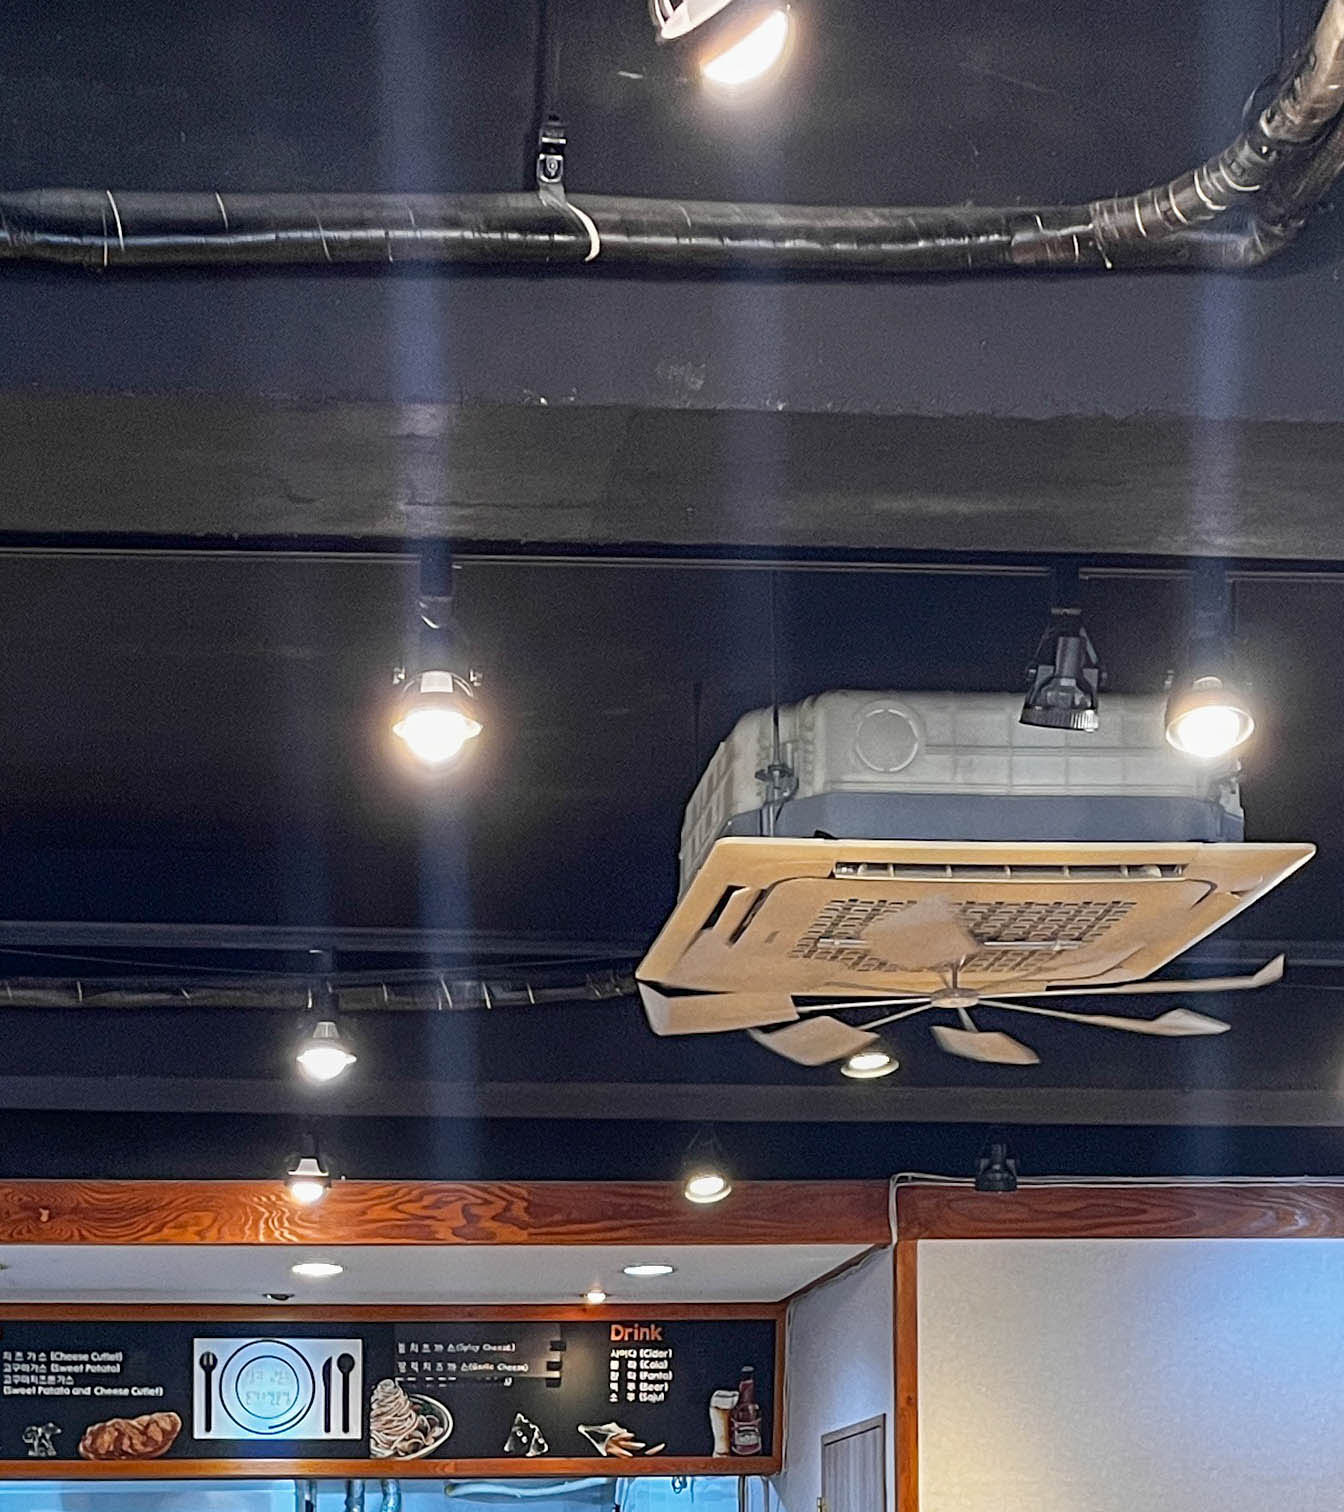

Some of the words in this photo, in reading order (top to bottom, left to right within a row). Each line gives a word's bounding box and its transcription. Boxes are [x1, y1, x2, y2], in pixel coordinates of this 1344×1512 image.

[610, 1323, 663, 1341] Drink
[50, 1351, 89, 1361] (Cheese
[639, 1349, 673, 1358] (Cider)
[639, 1360, 668, 1369] (Cola)
[639, 1371, 673, 1380] (Fanta)
[72, 1386, 91, 1395] and
[93, 1386, 130, 1395] Cheese
[639, 1382, 669, 1392] (Beer)
